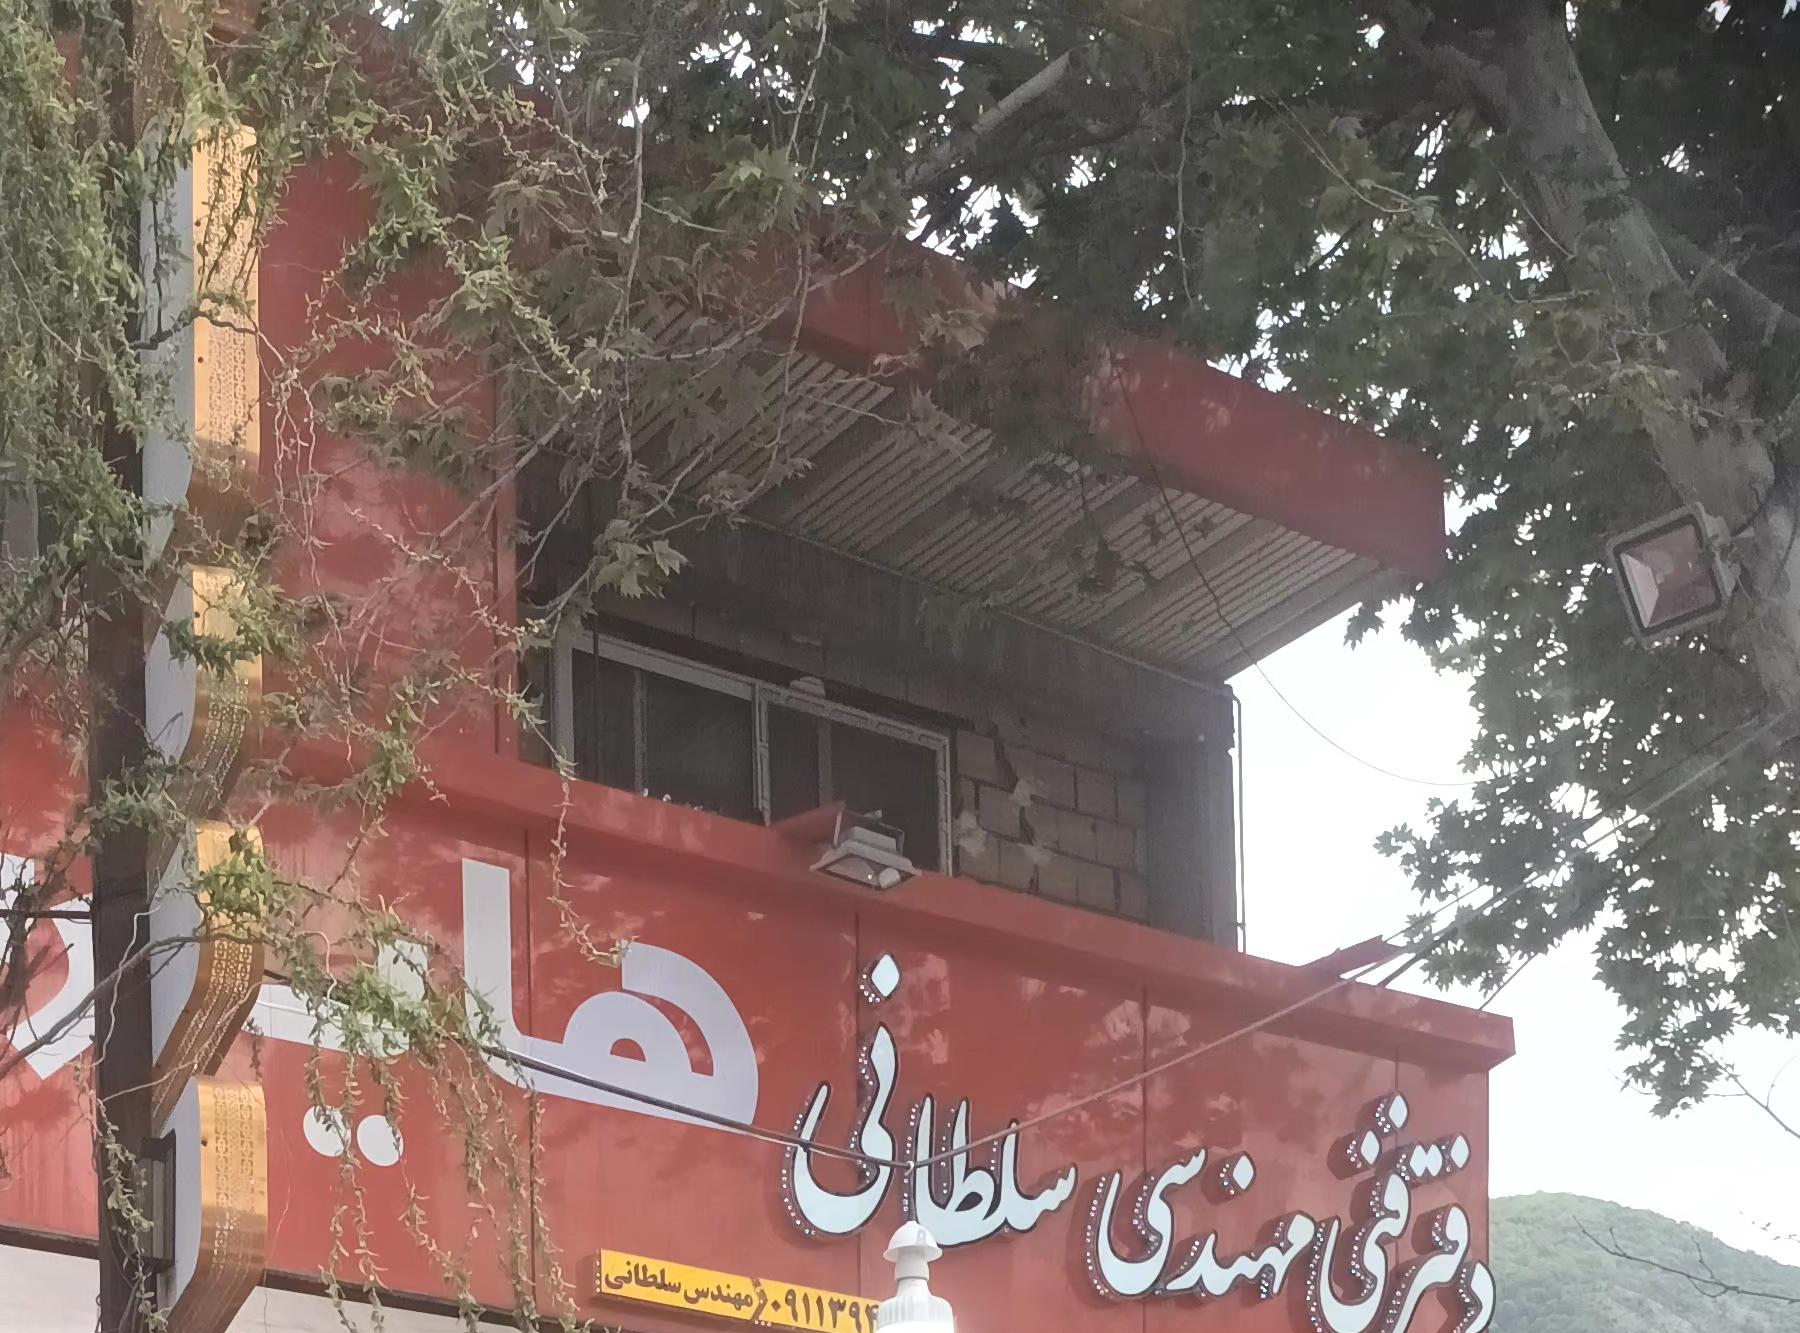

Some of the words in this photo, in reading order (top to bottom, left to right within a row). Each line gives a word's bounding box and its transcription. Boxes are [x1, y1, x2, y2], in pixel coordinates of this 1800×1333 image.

[790, 952, 1078, 1247] سلطانی
[1092, 1148, 1314, 1298] مهندسی
[604, 1259, 682, 1293] سلطانی
[683, 1283, 754, 1311] مهندس
